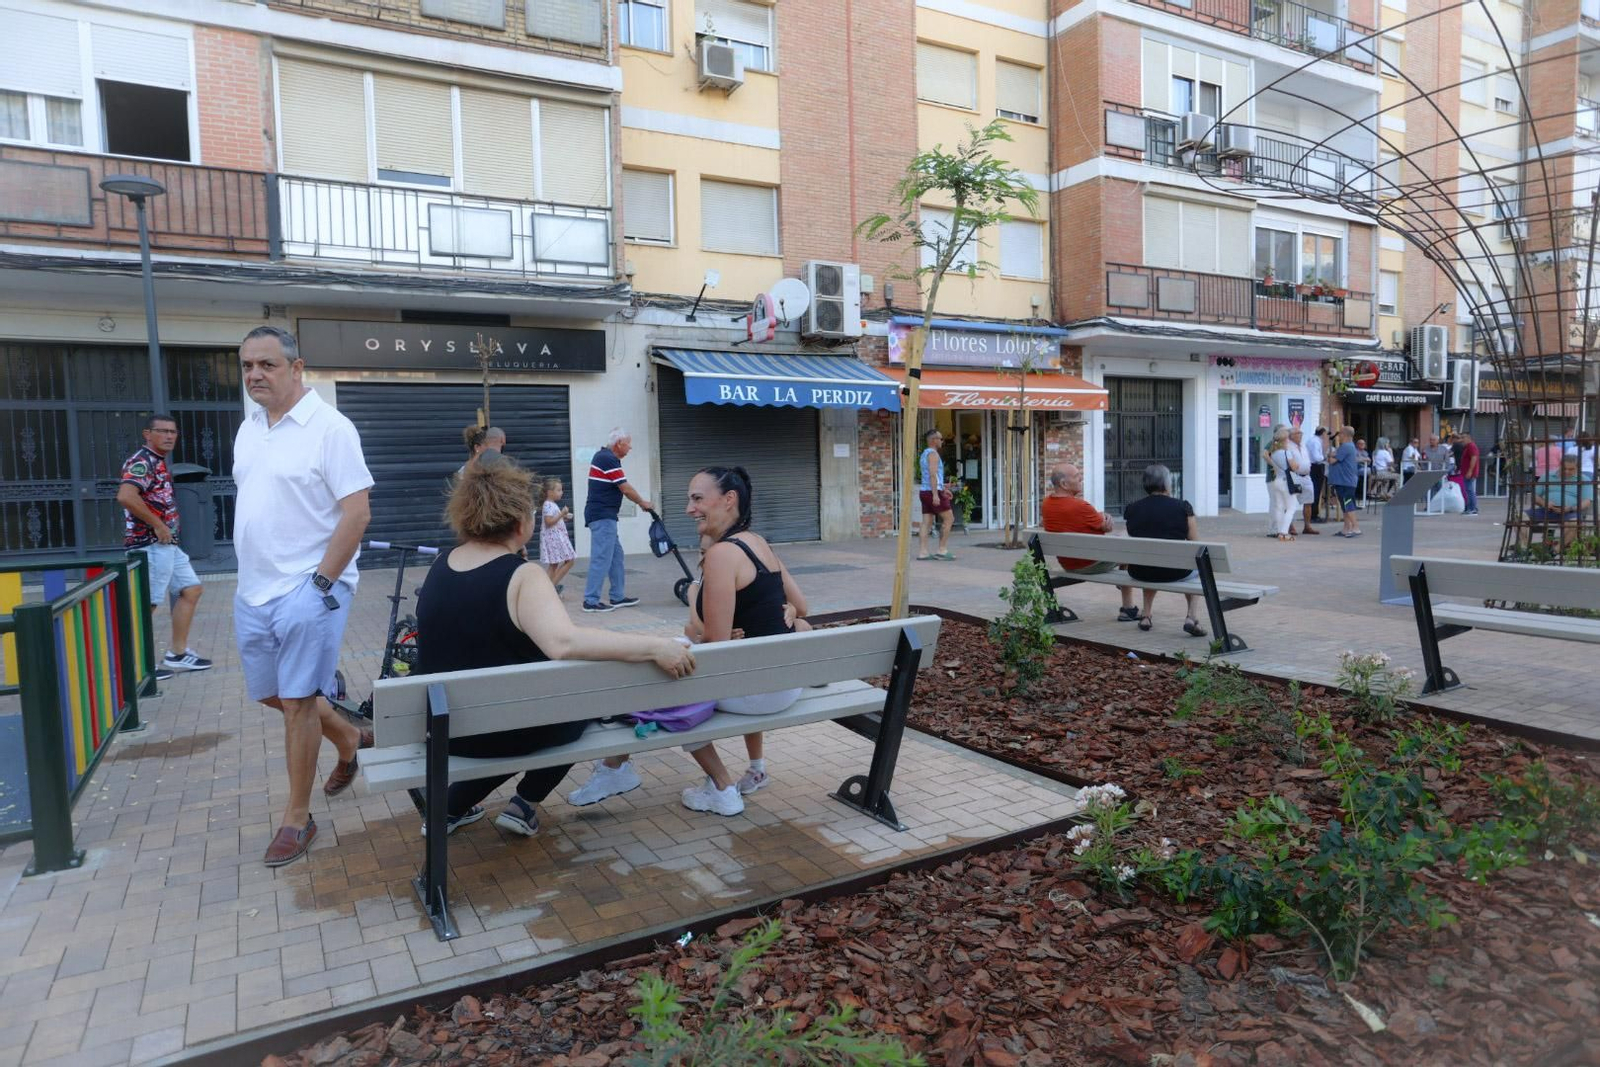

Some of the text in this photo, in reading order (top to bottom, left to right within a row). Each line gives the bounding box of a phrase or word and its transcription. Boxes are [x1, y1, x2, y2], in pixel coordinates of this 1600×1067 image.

[365, 338, 553, 356] ORYSLAVA
[931, 329, 1031, 356] Flores Lola
[718, 384, 874, 406] BAR LA PERDIZ
[941, 391, 1075, 407] Floristería
[1365, 393, 1428, 404] CAFÉ BAR LOS PITUFOS
